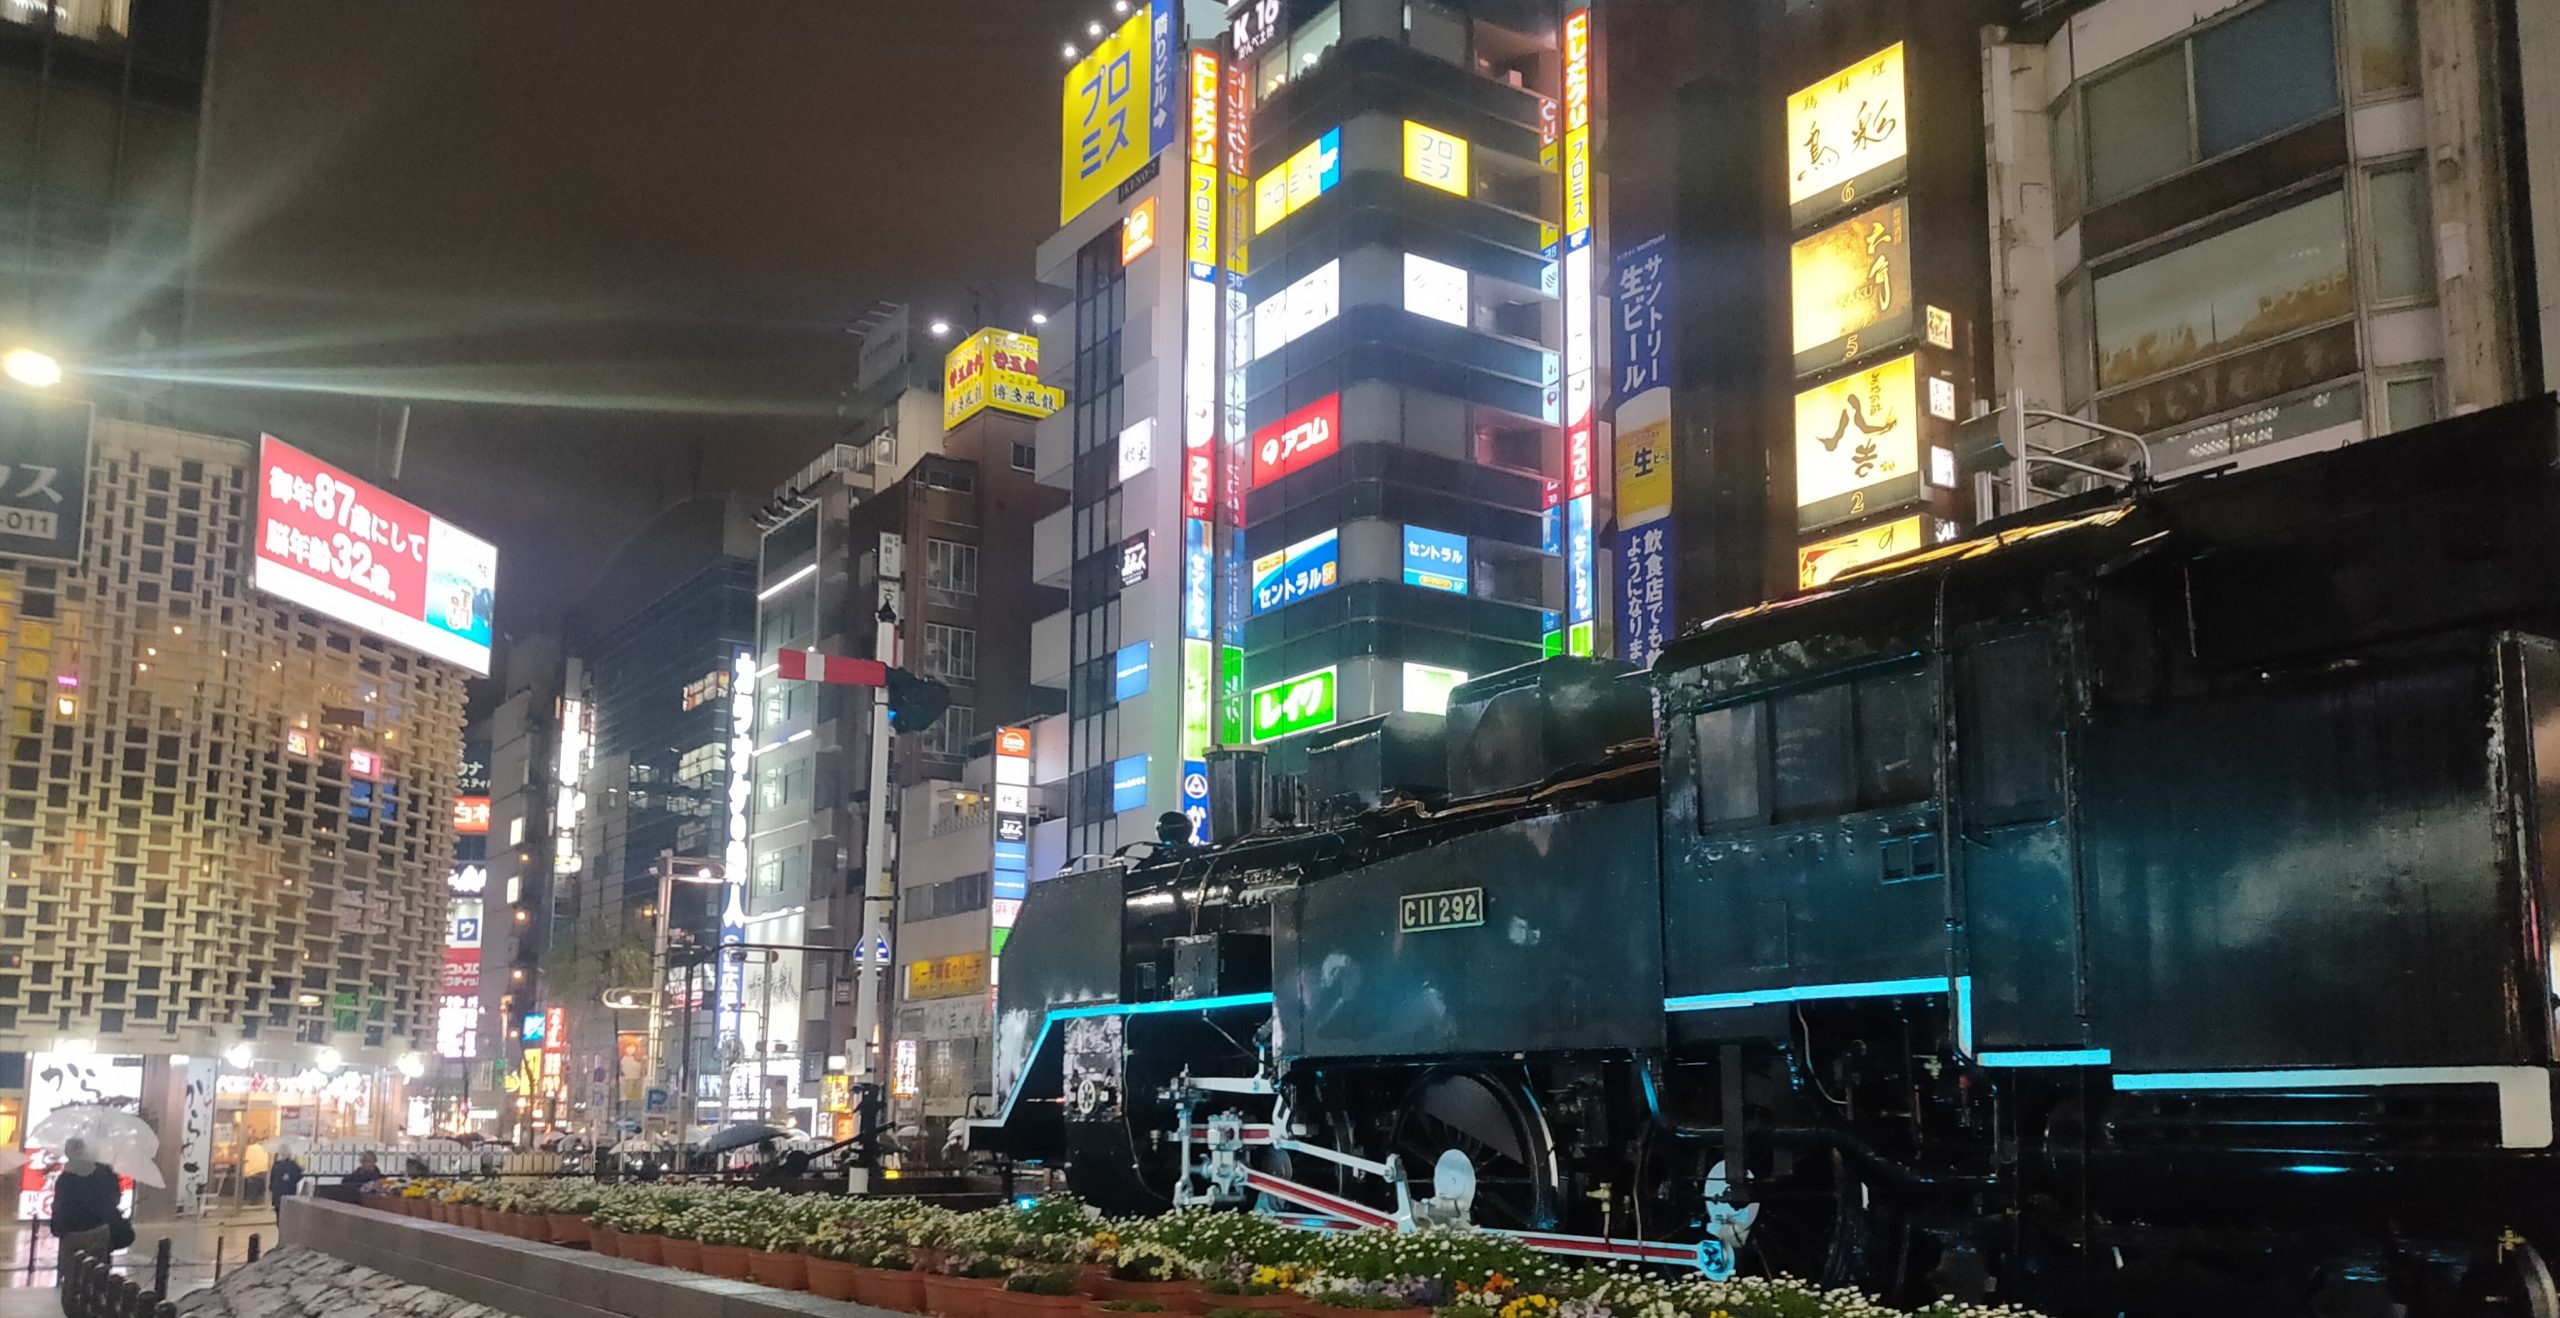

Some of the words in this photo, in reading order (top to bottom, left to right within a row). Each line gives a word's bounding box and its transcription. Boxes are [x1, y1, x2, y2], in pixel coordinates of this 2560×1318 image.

[1233, 11, 1251, 51] K
[1841, 179, 1855, 203] 6
[1620, 265, 1646, 392] 生ビール
[1644, 254, 1662, 381] サントリー
[1846, 334, 1859, 358] 5
[1281, 416, 1329, 461] アコム
[1633, 446, 1654, 478] 生
[0, 462, 64, 504] ス
[1851, 490, 1865, 514] 2
[1408, 539, 1463, 565] セントラル
[1258, 568, 1322, 610] セントラル
[1260, 677, 1324, 730] レイク
[1439, 894, 1478, 923] 292
